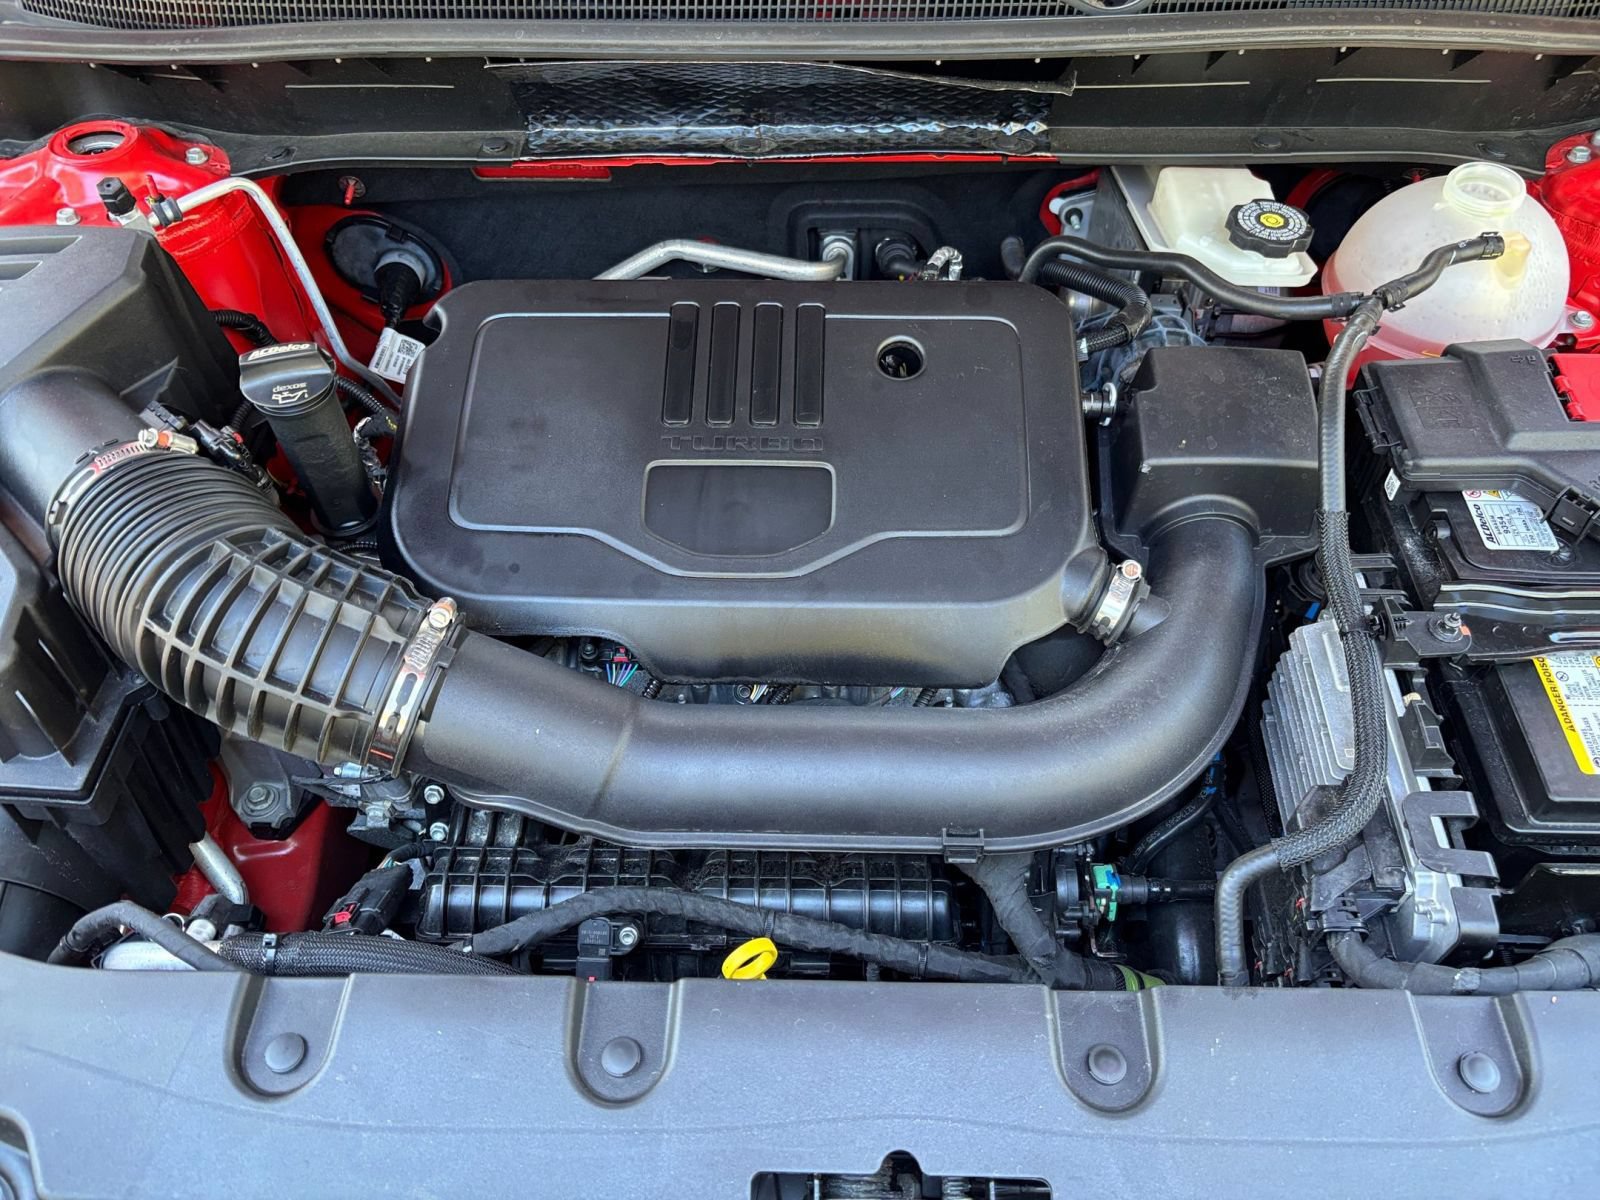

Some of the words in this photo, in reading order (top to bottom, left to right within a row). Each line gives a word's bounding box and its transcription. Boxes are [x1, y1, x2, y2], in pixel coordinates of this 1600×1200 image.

[247, 343, 311, 361] ACDelco
[660, 435, 824, 451] TURBO
[1473, 503, 1497, 544] ACDelco
[1536, 656, 1574, 727] DANGER/POISO
